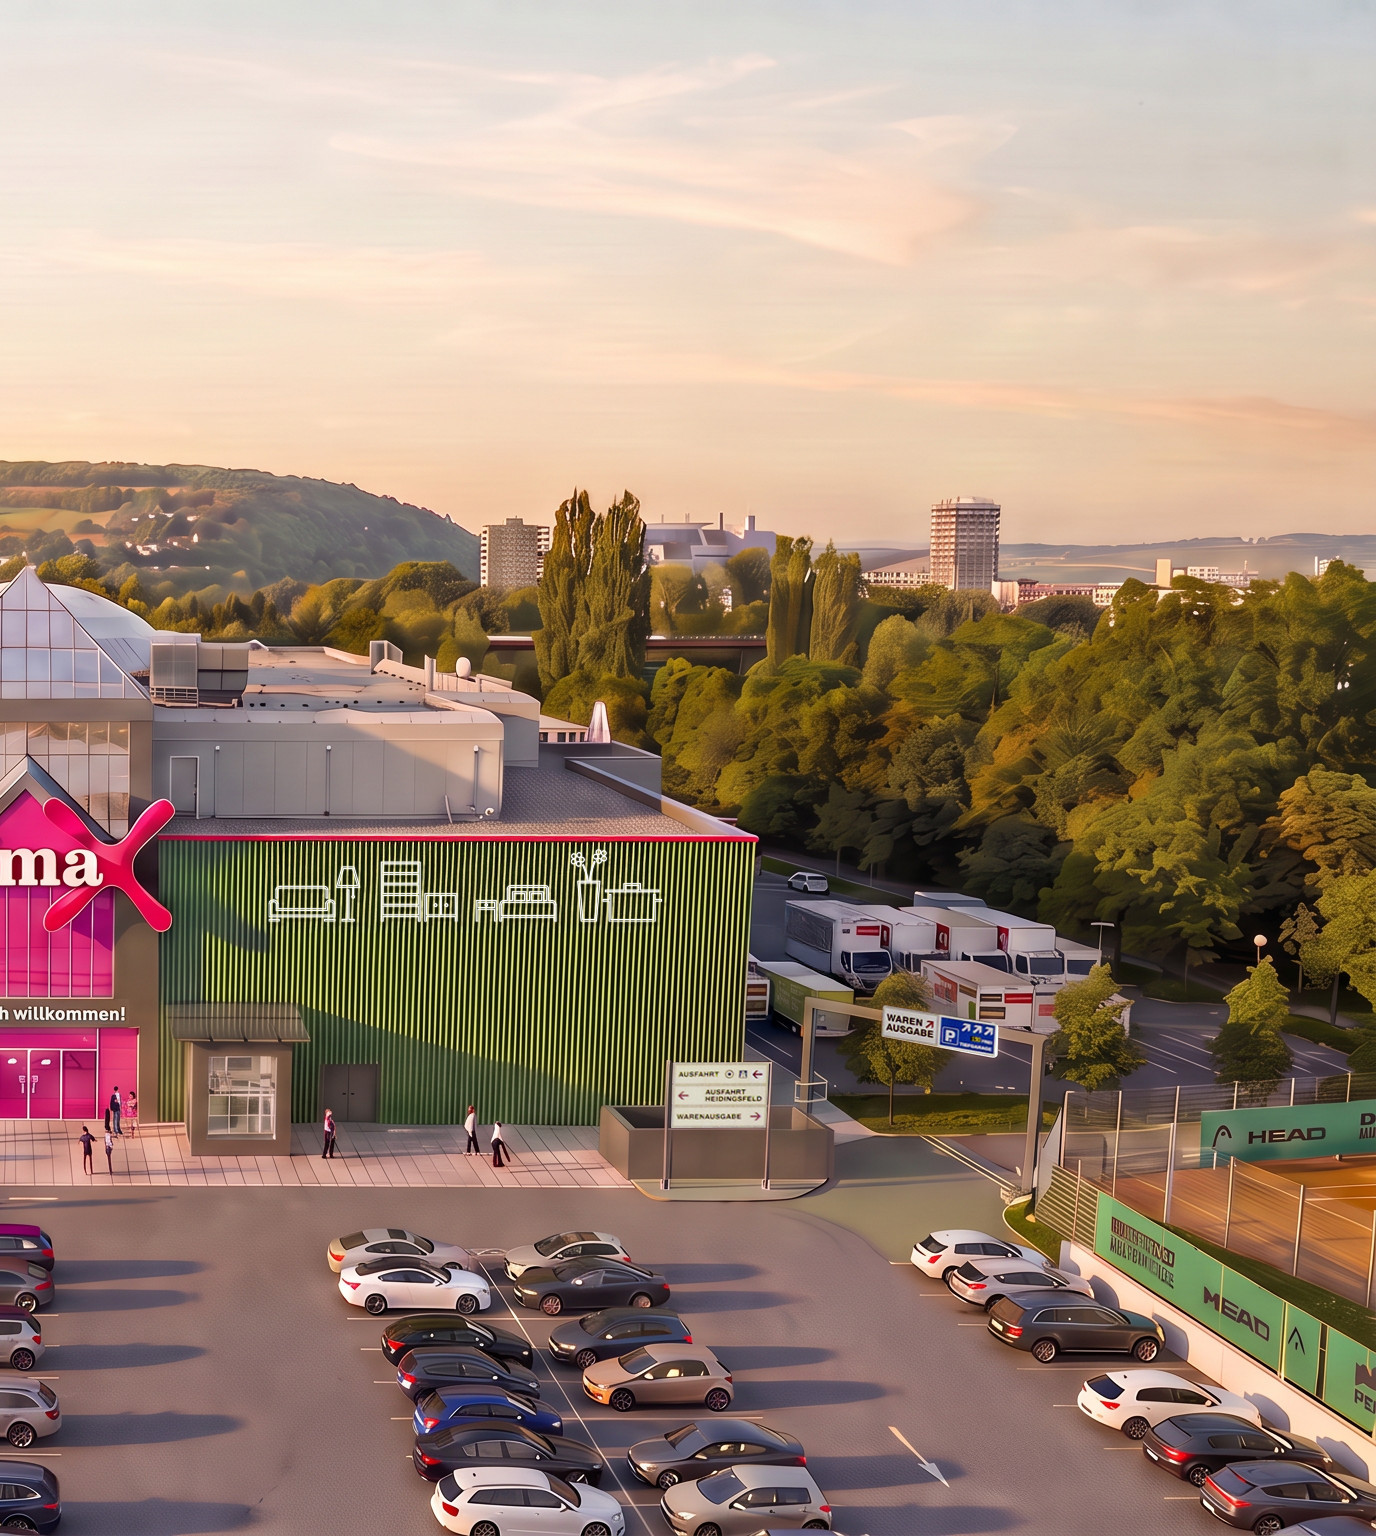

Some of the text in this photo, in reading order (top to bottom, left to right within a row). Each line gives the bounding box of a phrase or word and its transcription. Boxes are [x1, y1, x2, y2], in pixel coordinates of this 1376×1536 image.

[20, 1006, 126, 1022] willkommen!
[886, 1013, 923, 1027] WAREN
[886, 1023, 934, 1039] AUSGABE
[1248, 1126, 1326, 1144] HEAD
